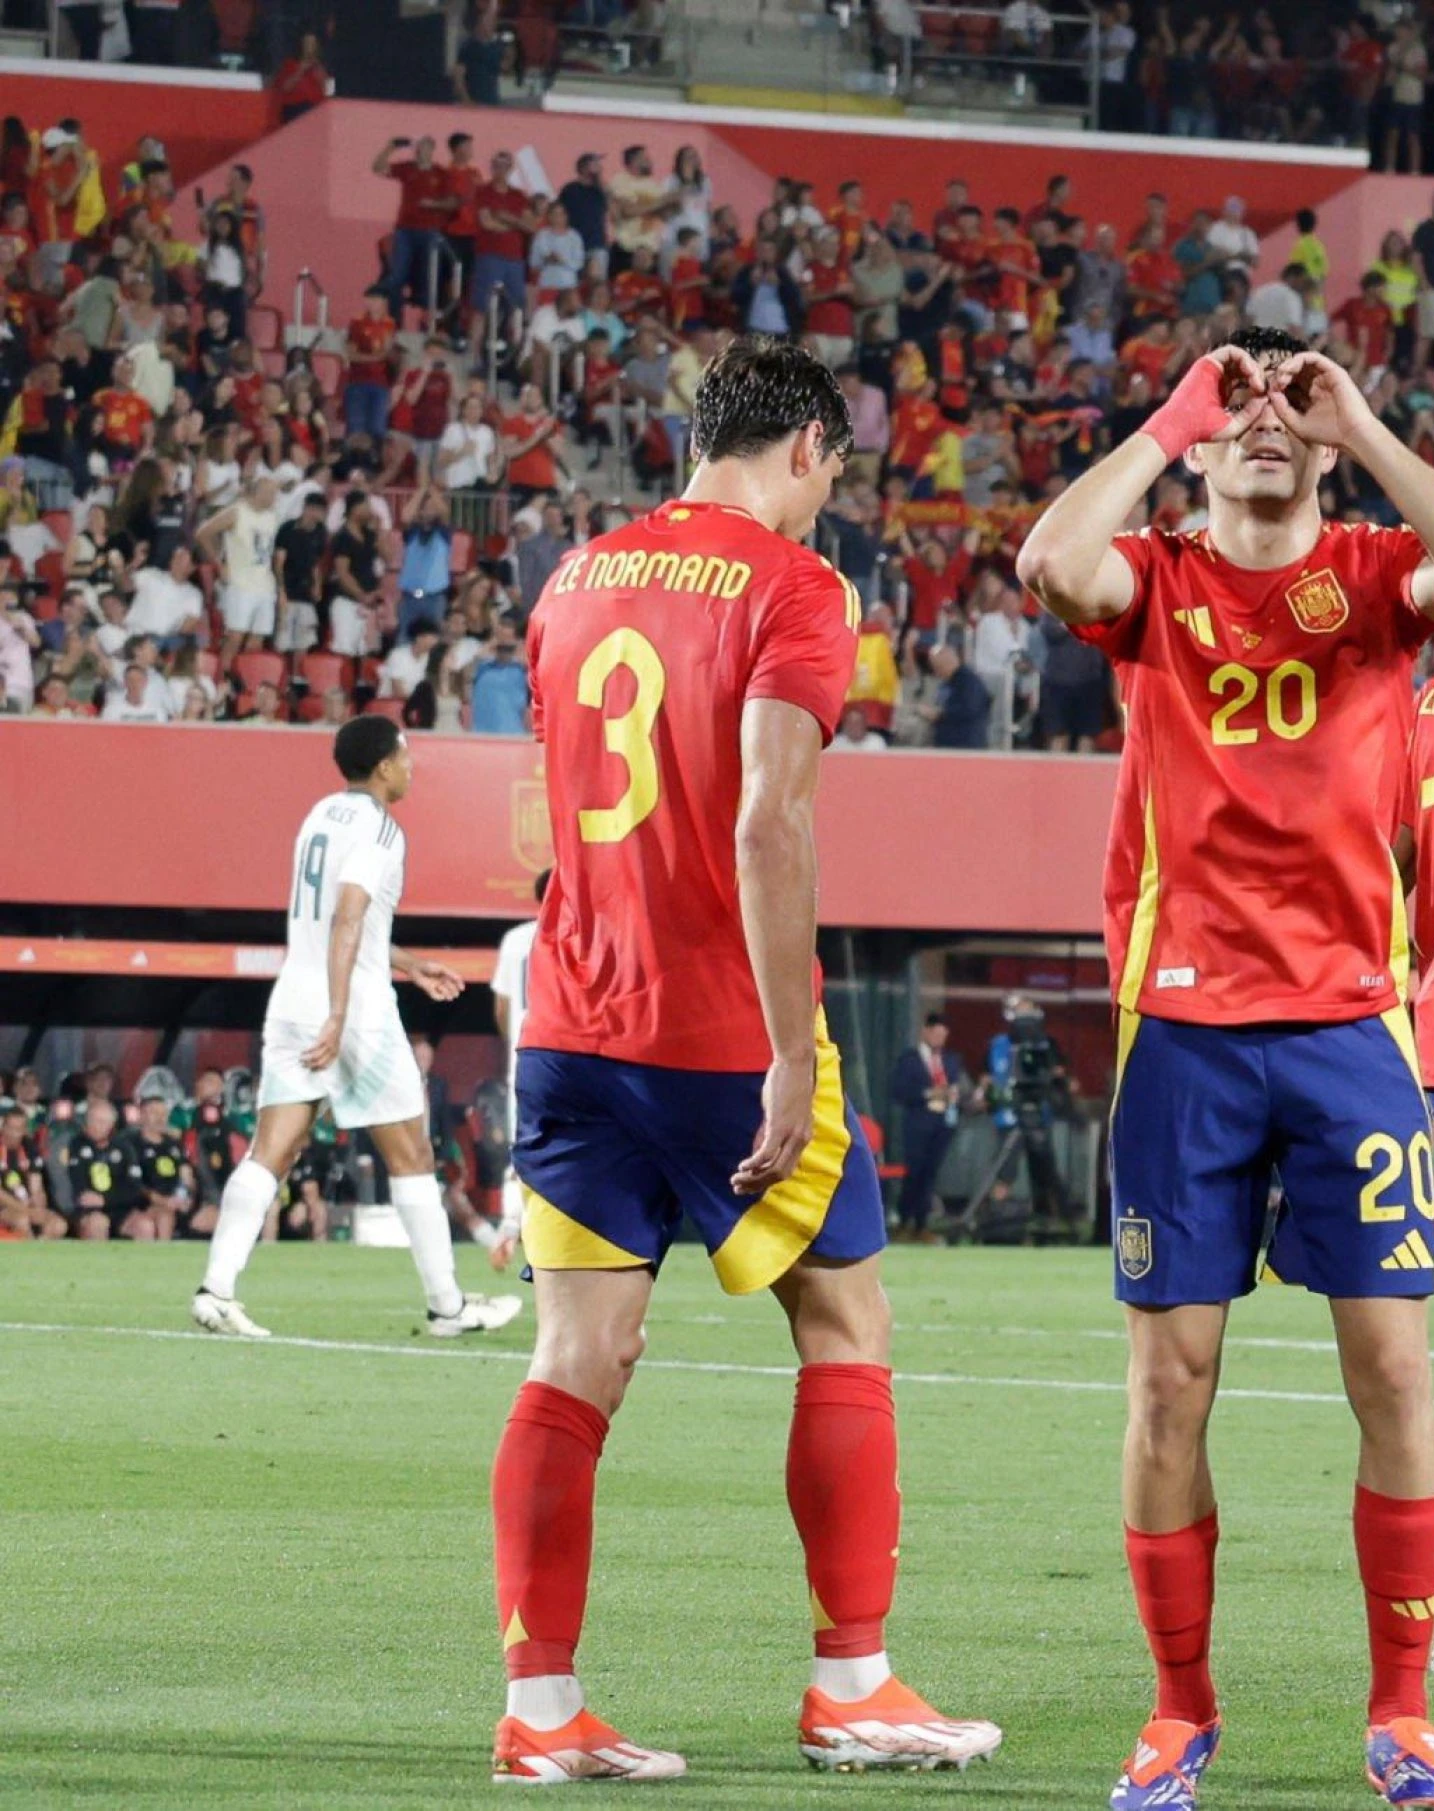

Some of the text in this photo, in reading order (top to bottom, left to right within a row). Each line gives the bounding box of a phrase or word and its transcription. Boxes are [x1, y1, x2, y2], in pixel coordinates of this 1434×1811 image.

[584, 549, 752, 599] NORMAND
[577, 627, 666, 842] 3
[1209, 660, 1317, 745] 20
[294, 833, 329, 921] 19
